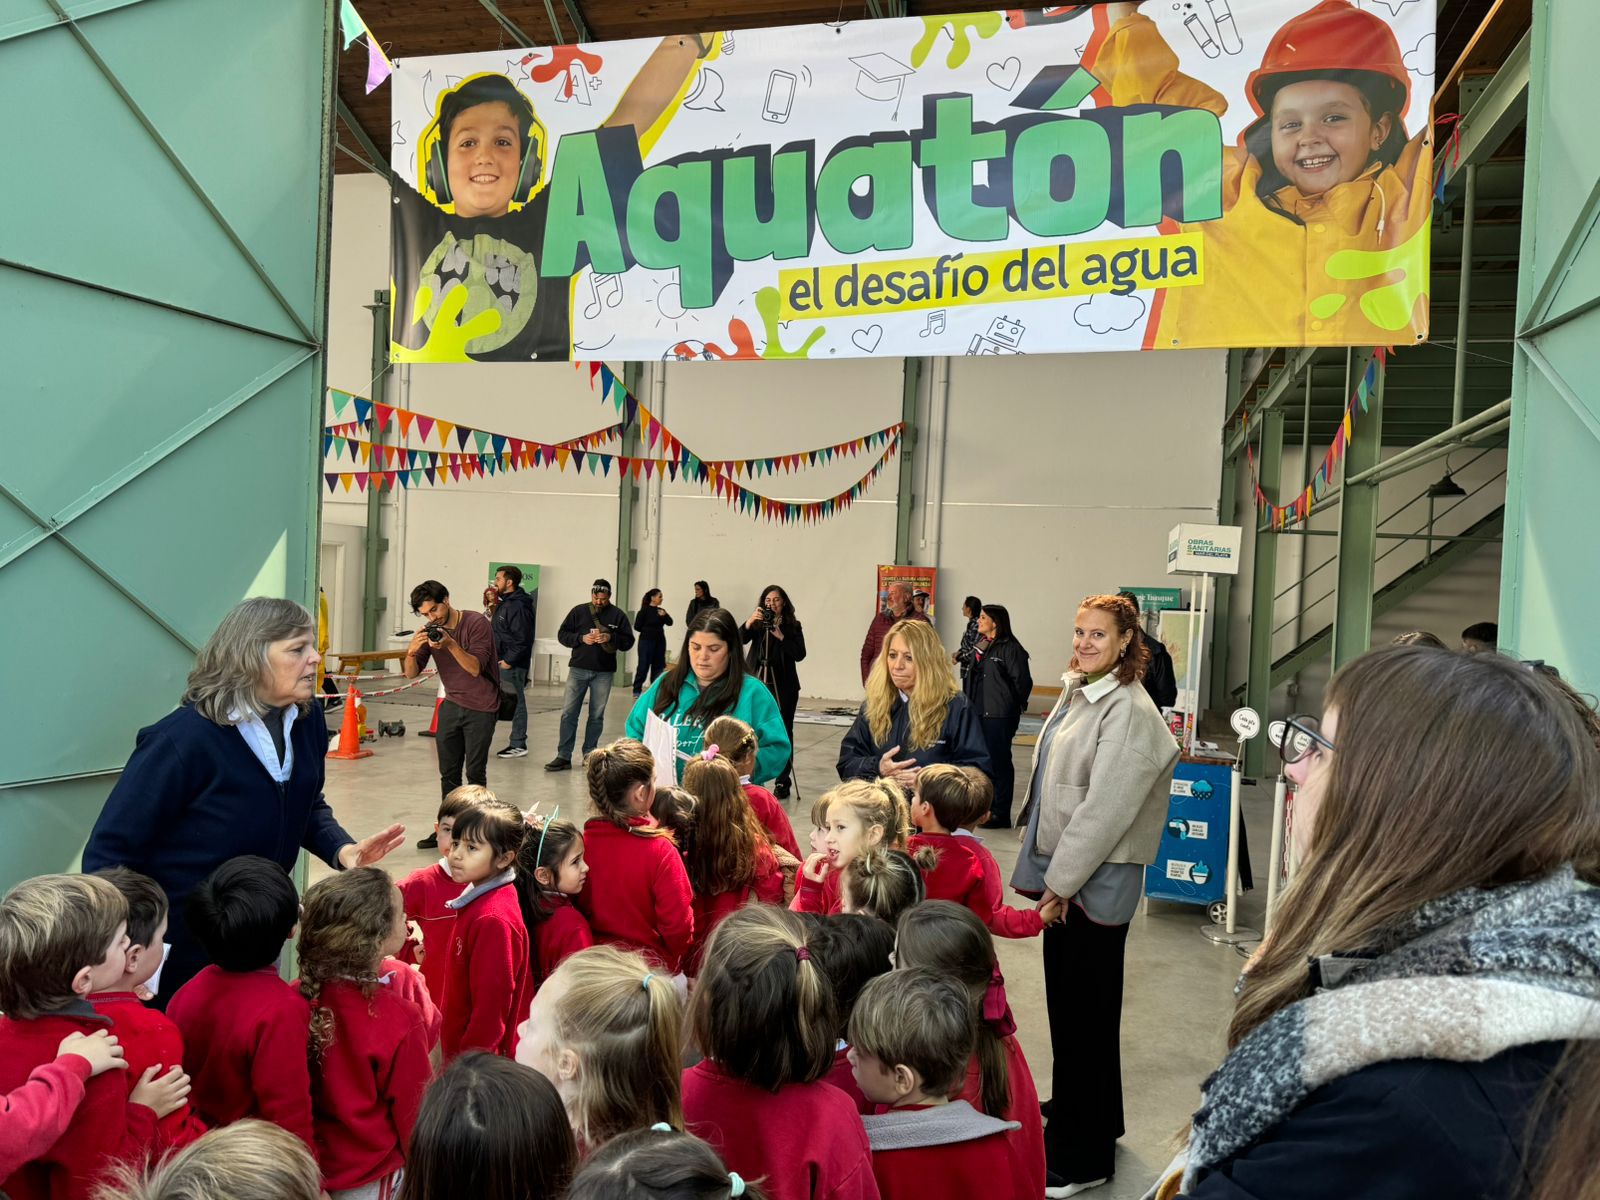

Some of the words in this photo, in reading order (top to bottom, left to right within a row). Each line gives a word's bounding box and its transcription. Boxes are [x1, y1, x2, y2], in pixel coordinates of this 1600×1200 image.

[541, 64, 1224, 309] Aquatón
[789, 266, 824, 312] el
[834, 252, 990, 308] desafío
[1002, 243, 1070, 293] del
[1081, 245, 1198, 296] agua
[1186, 544, 1232, 553] SANITARIAS
[1187, 538, 1214, 546] OBRAS
